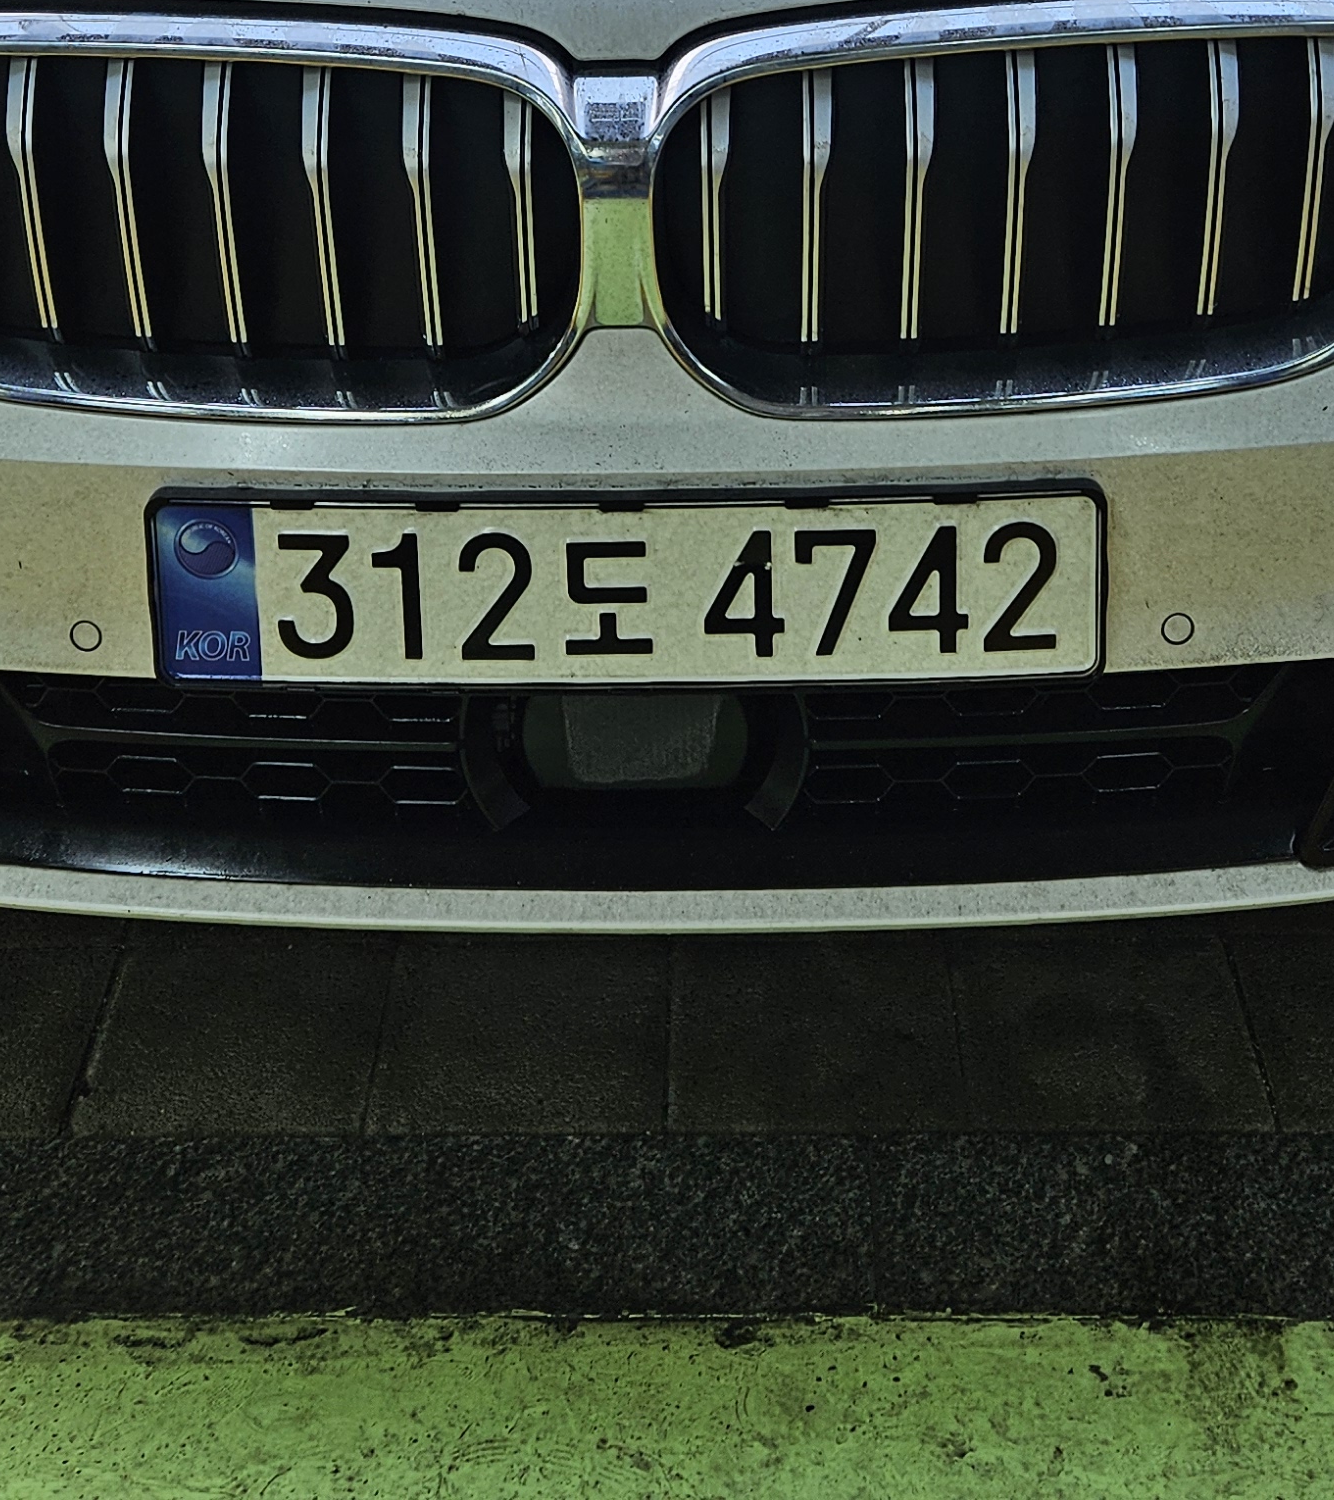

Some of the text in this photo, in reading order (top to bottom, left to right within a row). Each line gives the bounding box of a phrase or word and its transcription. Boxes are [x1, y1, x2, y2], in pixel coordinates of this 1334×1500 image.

[276, 521, 1058, 661] 312도 4742
[175, 630, 251, 662] KOR
